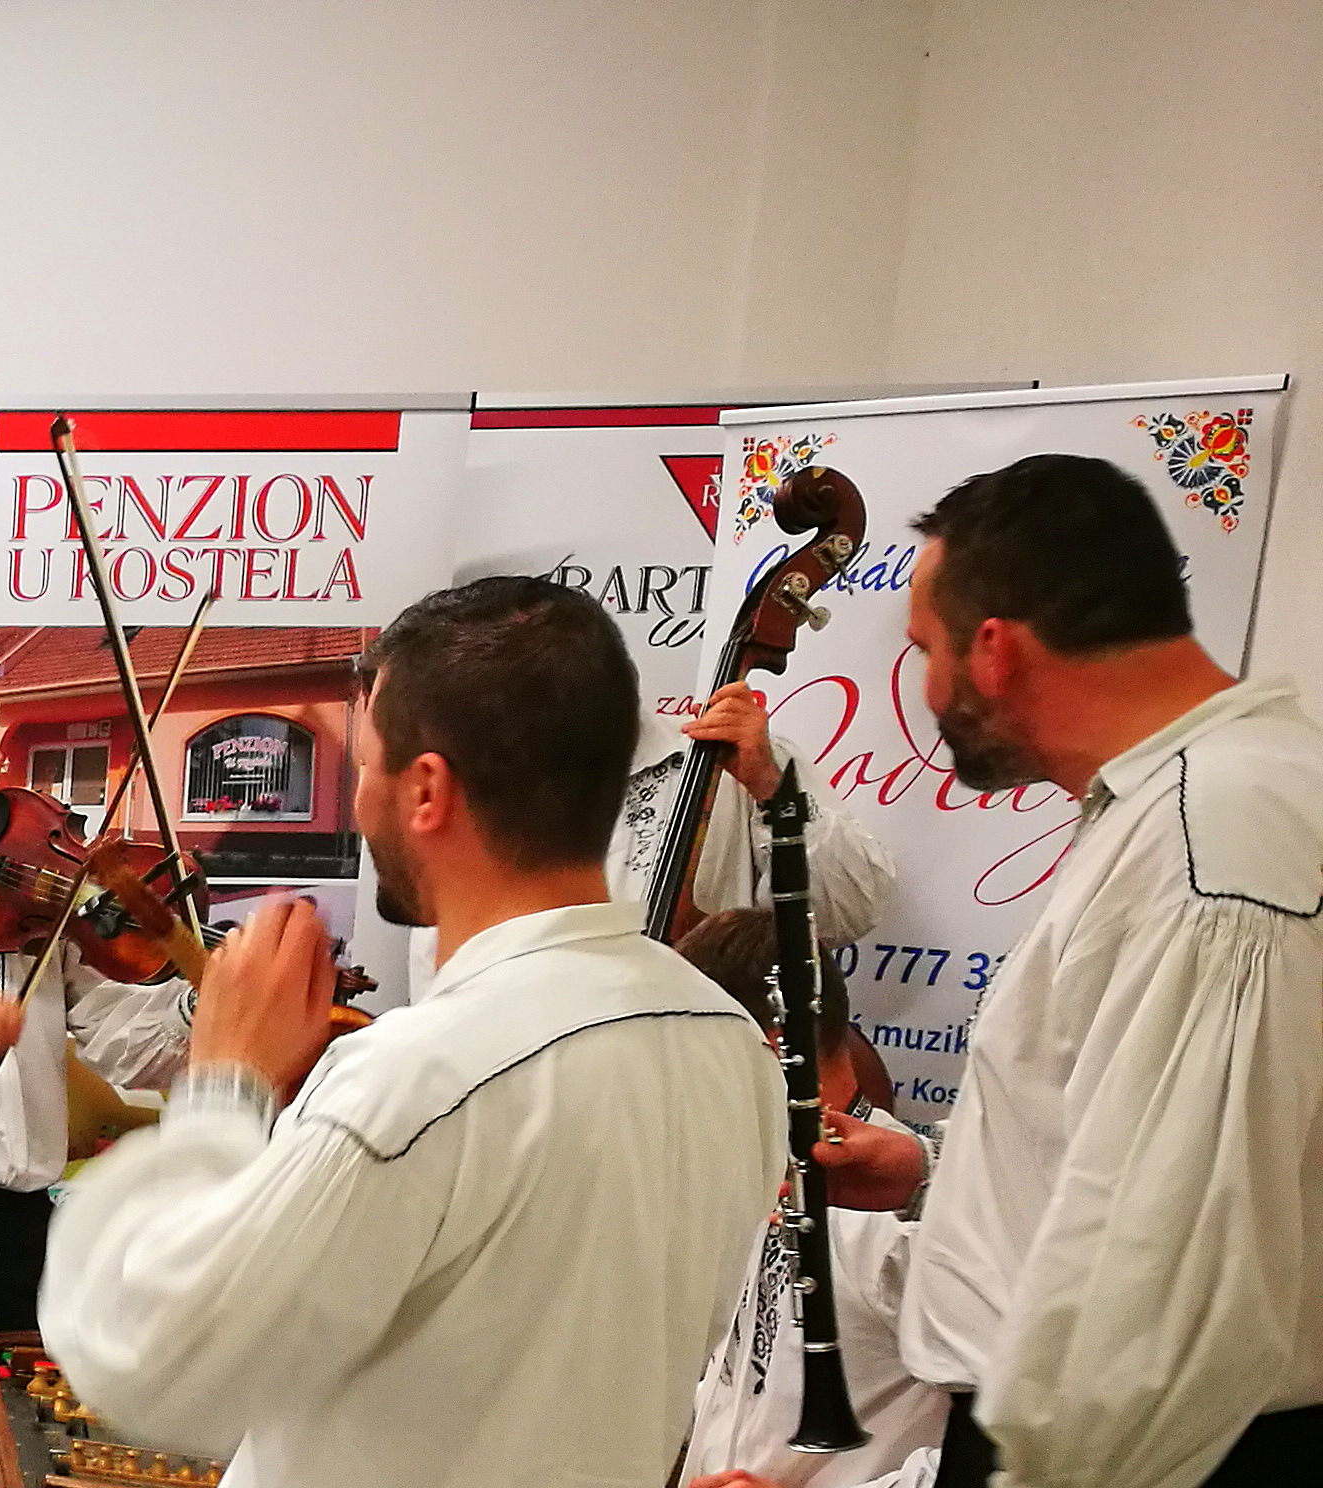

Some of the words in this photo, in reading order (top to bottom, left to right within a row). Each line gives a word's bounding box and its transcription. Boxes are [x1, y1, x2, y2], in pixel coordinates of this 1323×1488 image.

[8, 474, 374, 542] PENZION
[8, 548, 55, 600] U
[70, 547, 363, 602] KOSTELA
[874, 943, 951, 986] 777
[962, 951, 1007, 990] 3
